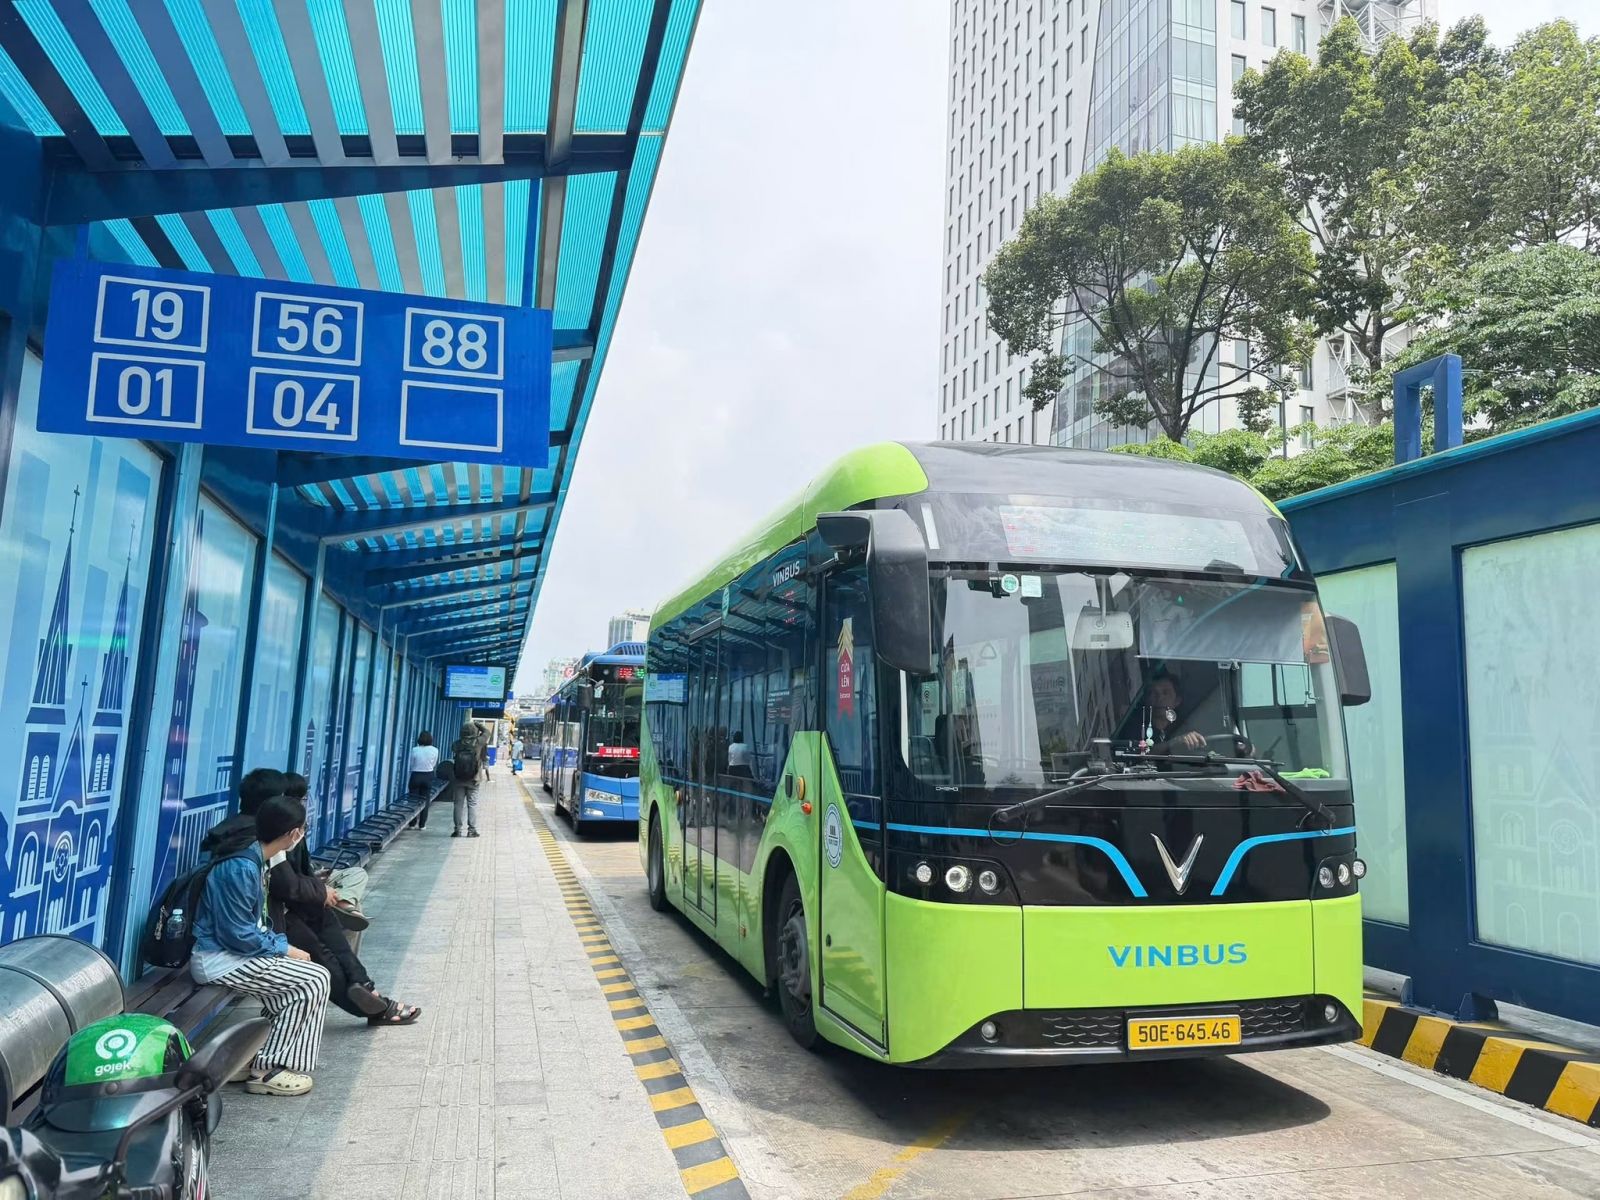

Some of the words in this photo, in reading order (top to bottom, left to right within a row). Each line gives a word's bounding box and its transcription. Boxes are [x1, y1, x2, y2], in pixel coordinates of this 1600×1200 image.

[130, 288, 184, 341] 19
[276, 303, 343, 355] 56
[420, 319, 488, 369] 88
[117, 365, 172, 417] 01
[271, 379, 340, 431] 04
[772, 561, 800, 587] VINBUS
[1107, 943, 1247, 967] VINBUS
[1138, 1022, 1231, 1043] 50E-645.46
[95, 1060, 132, 1076] gojek
